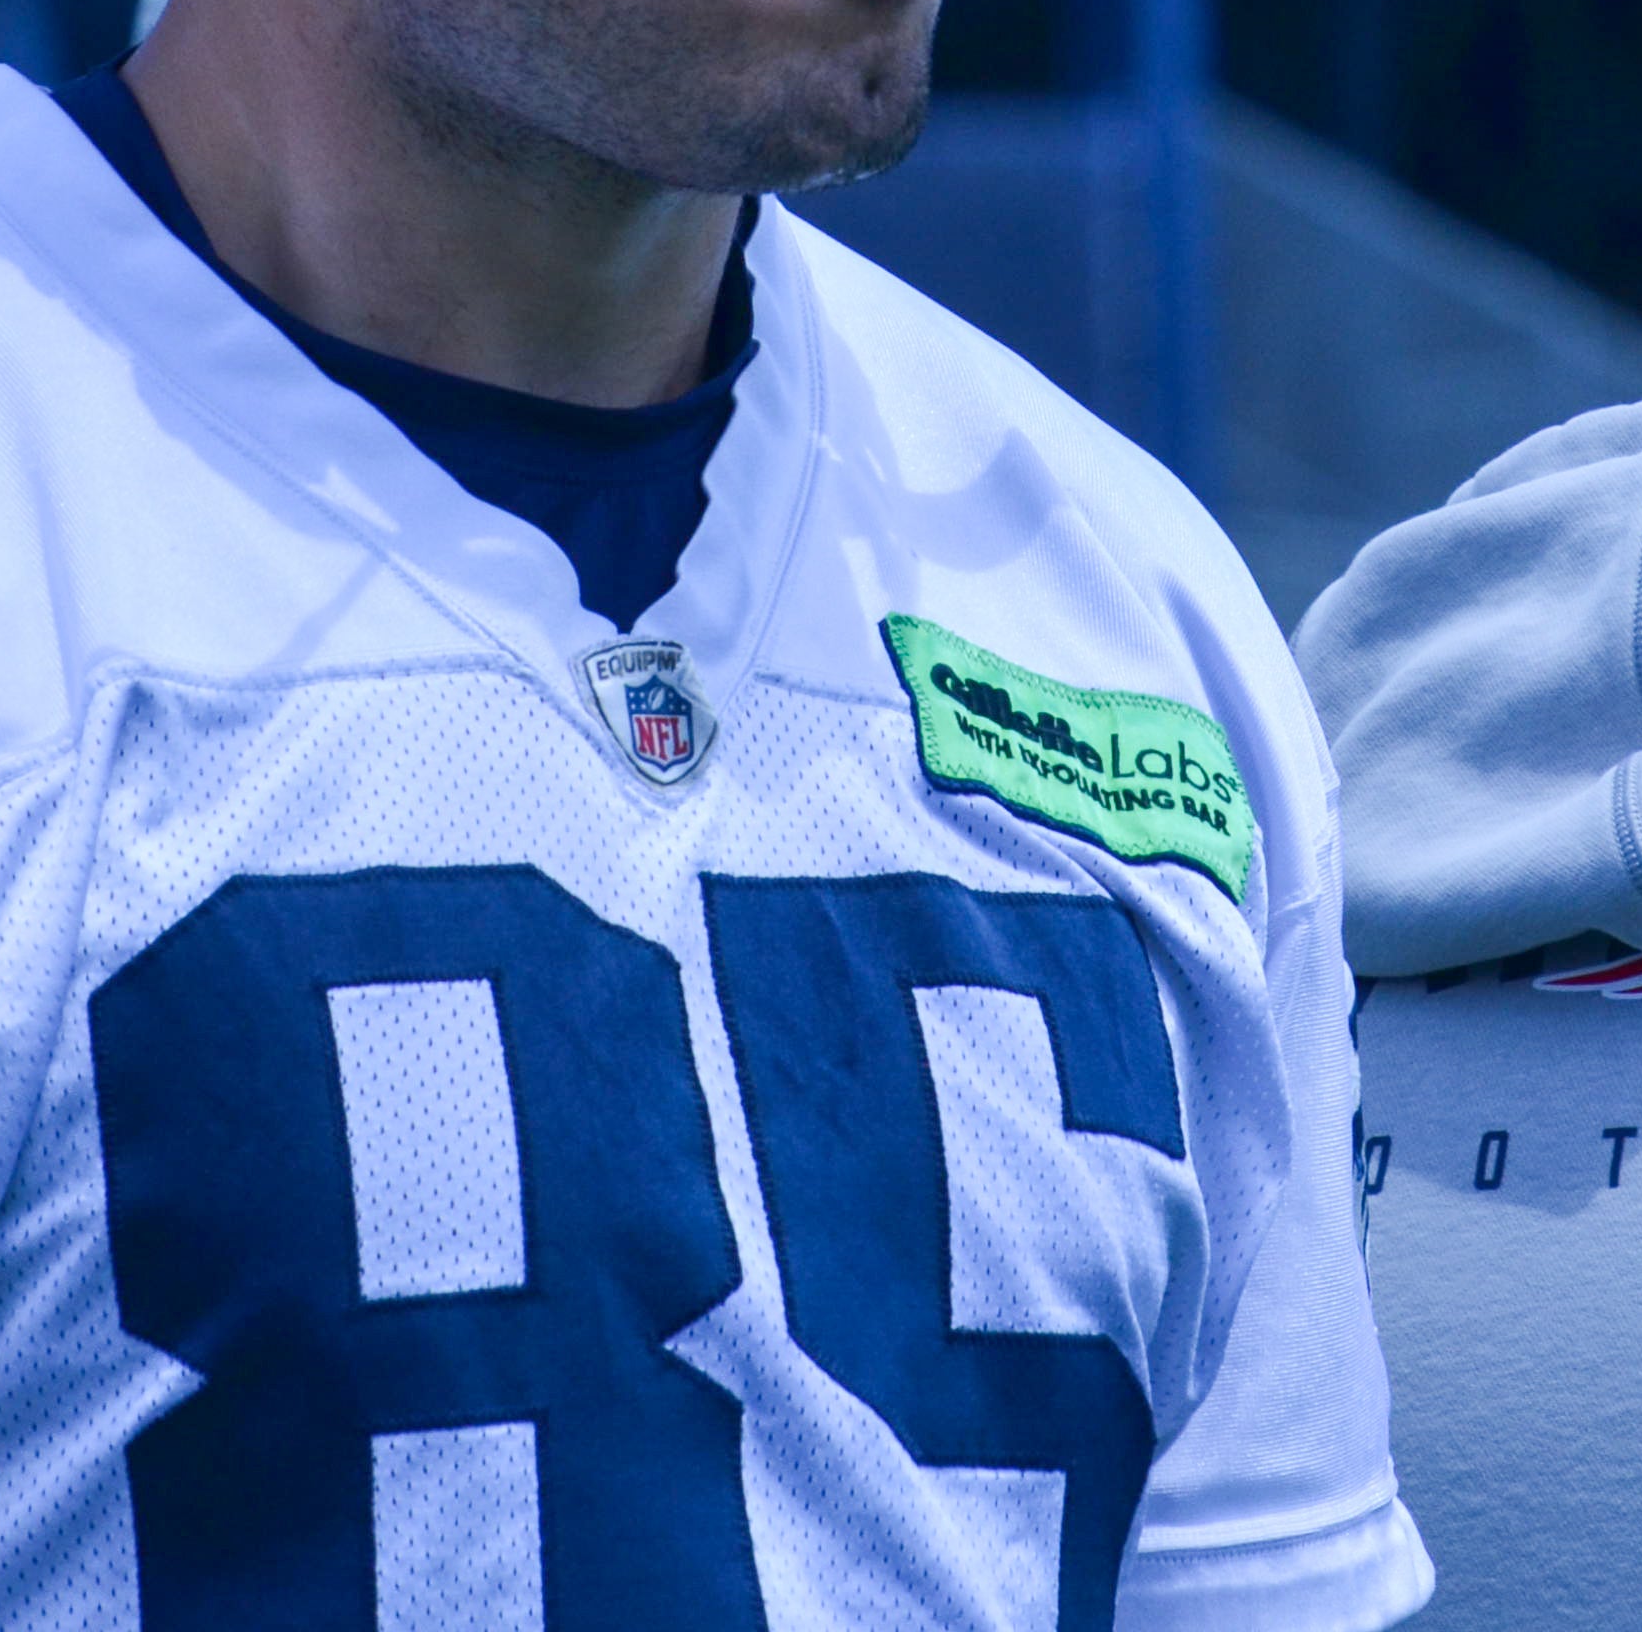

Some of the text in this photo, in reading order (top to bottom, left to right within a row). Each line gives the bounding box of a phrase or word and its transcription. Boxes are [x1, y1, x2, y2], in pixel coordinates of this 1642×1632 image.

[596, 649, 682, 681] EQUIPM
[634, 716, 689, 762] NFL
[954, 710, 1014, 759] WITH
[1181, 795, 1231, 837] BAR
[88, 863, 1186, 1632] 85
